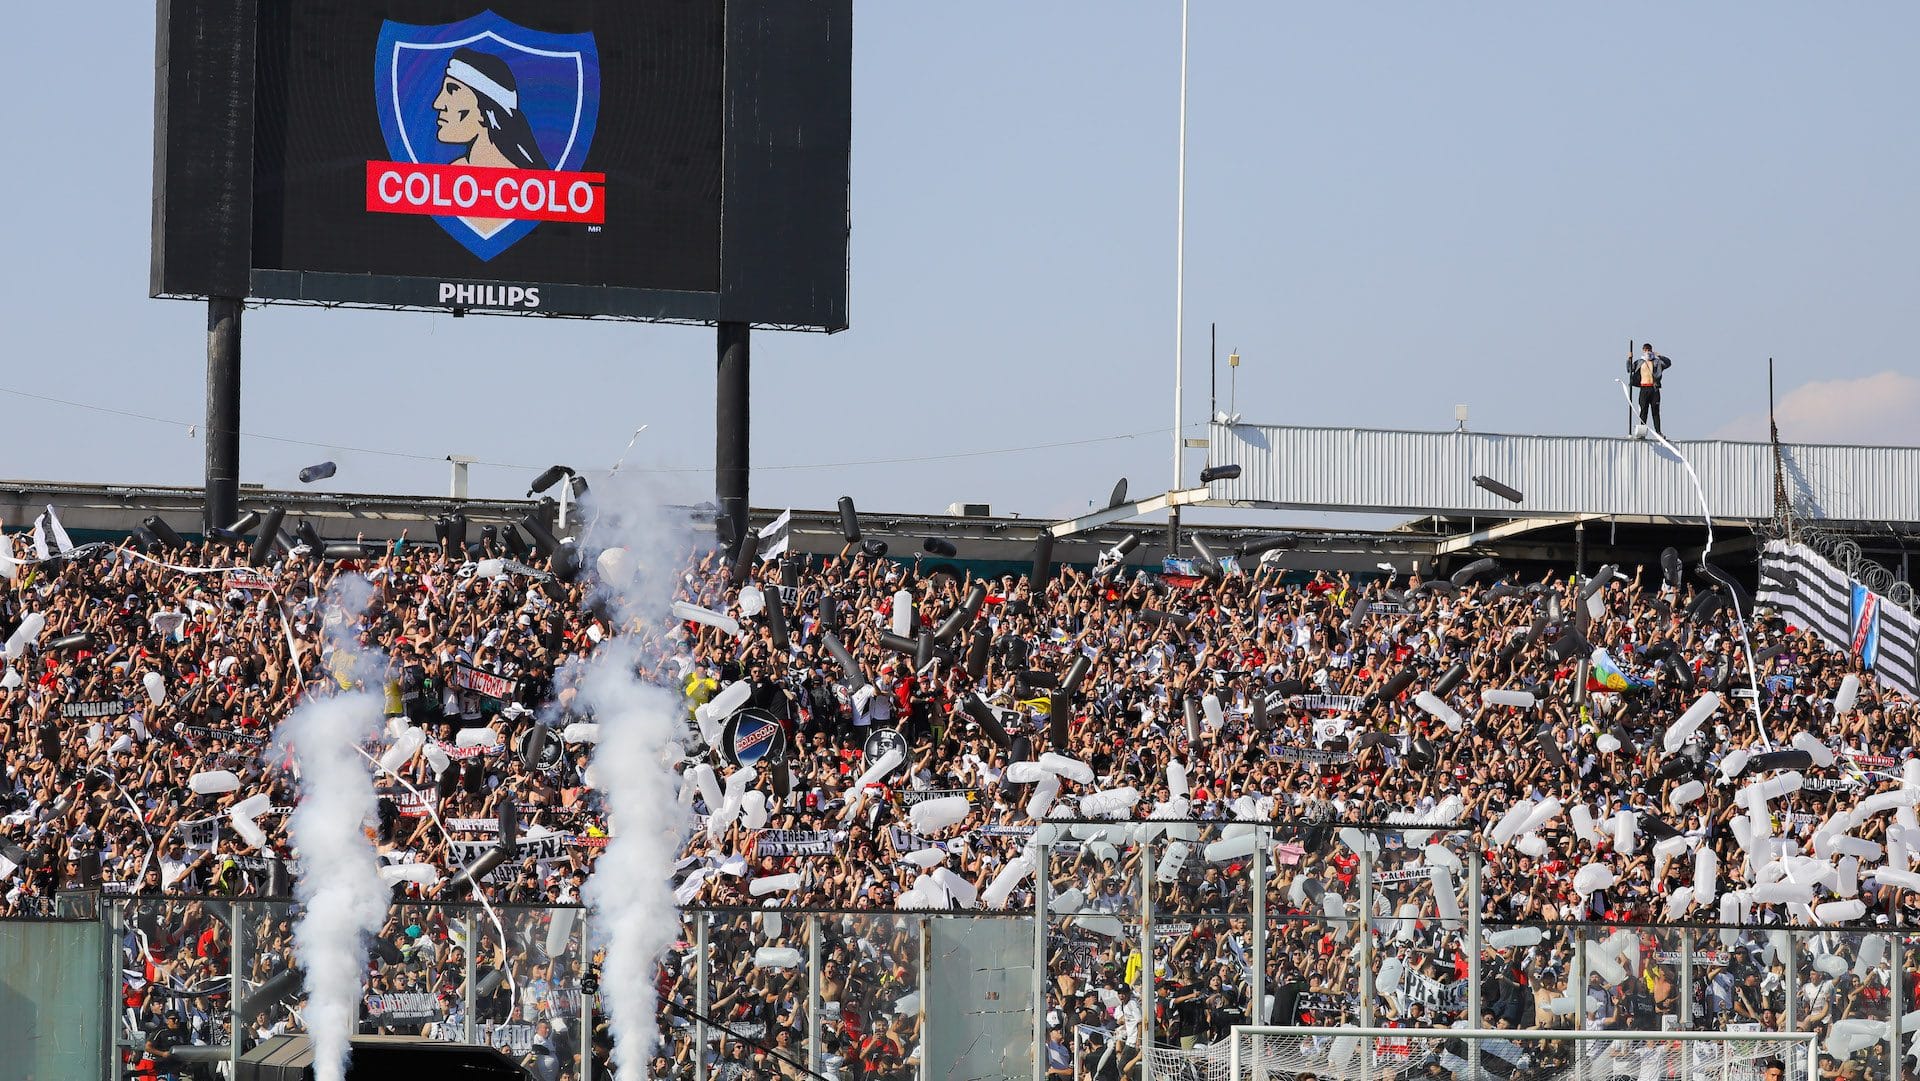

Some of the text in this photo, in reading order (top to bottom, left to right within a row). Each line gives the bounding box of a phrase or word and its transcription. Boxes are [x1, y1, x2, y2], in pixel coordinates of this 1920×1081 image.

[378, 170, 594, 214] COLO-COLO
[439, 282, 540, 308] PHILIPS
[1853, 754, 1895, 768] MALDITOS
